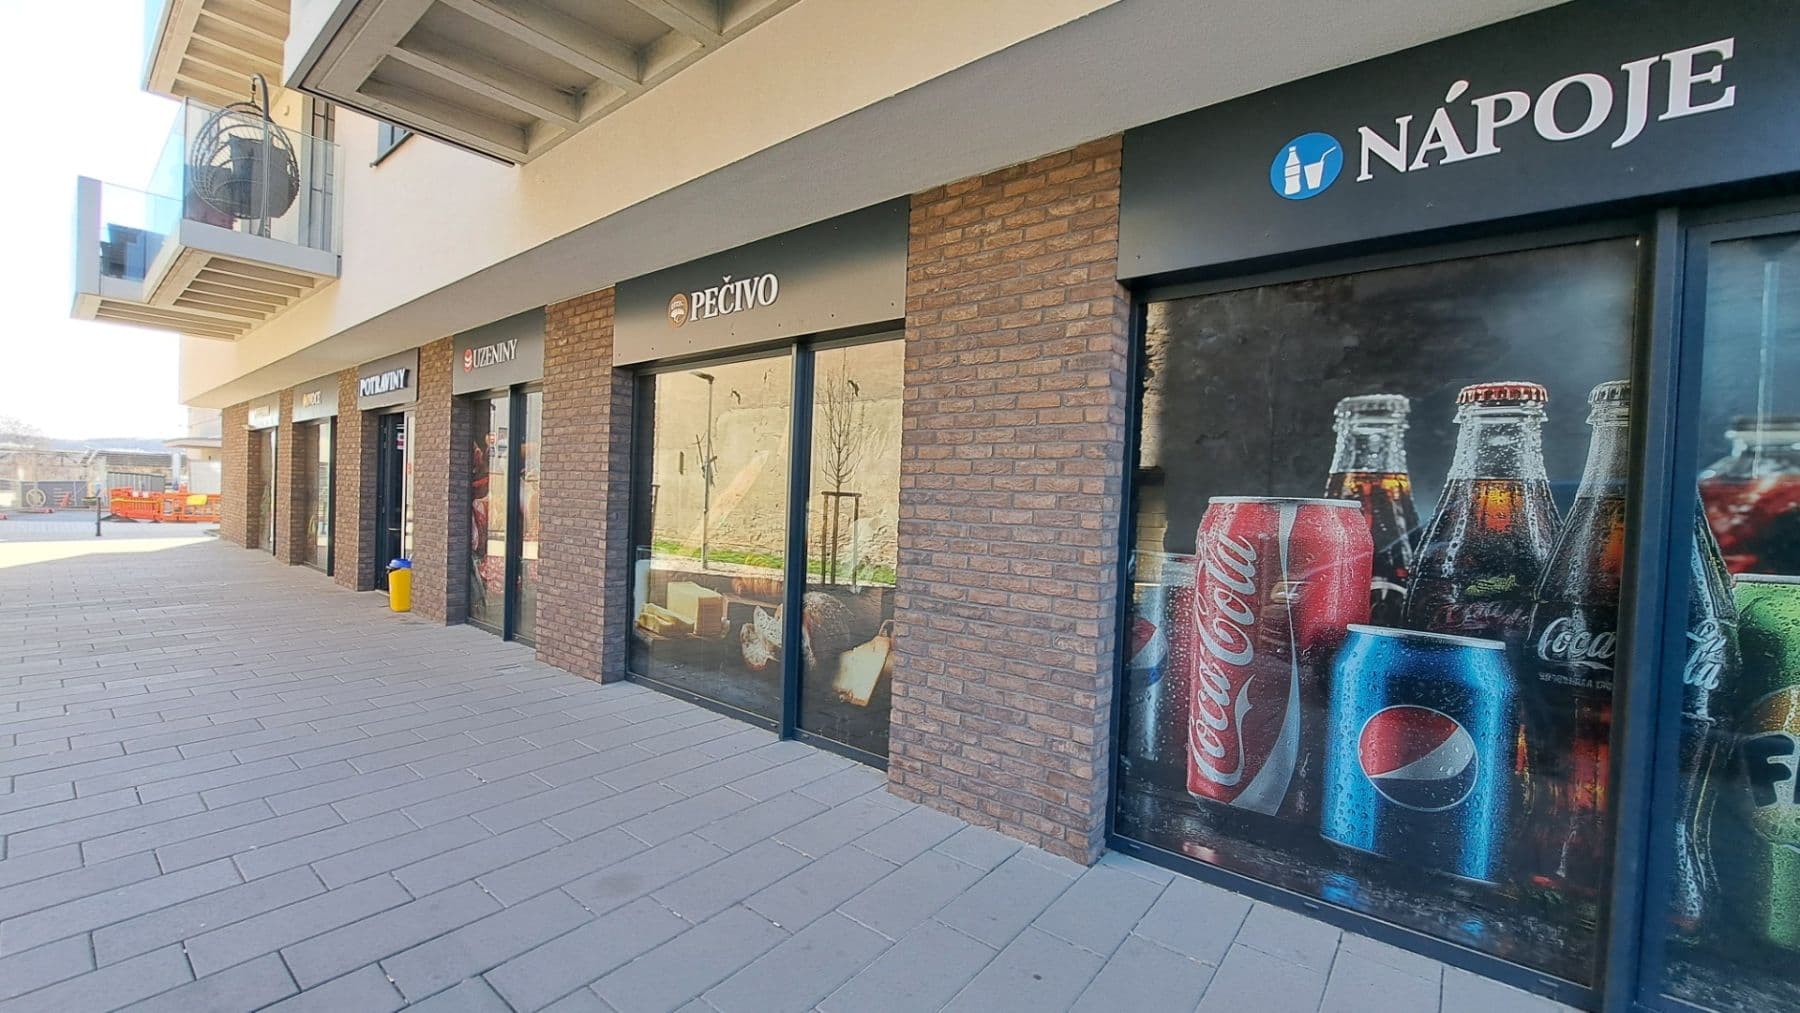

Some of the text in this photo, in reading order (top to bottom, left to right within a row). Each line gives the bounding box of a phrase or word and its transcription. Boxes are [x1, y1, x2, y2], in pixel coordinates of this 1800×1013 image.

[1355, 37, 1736, 182] NÁPOJE
[689, 273, 779, 321] PEČIVO
[473, 338, 518, 368] UZENINY
[359, 367, 407, 397] POTRAVINY
